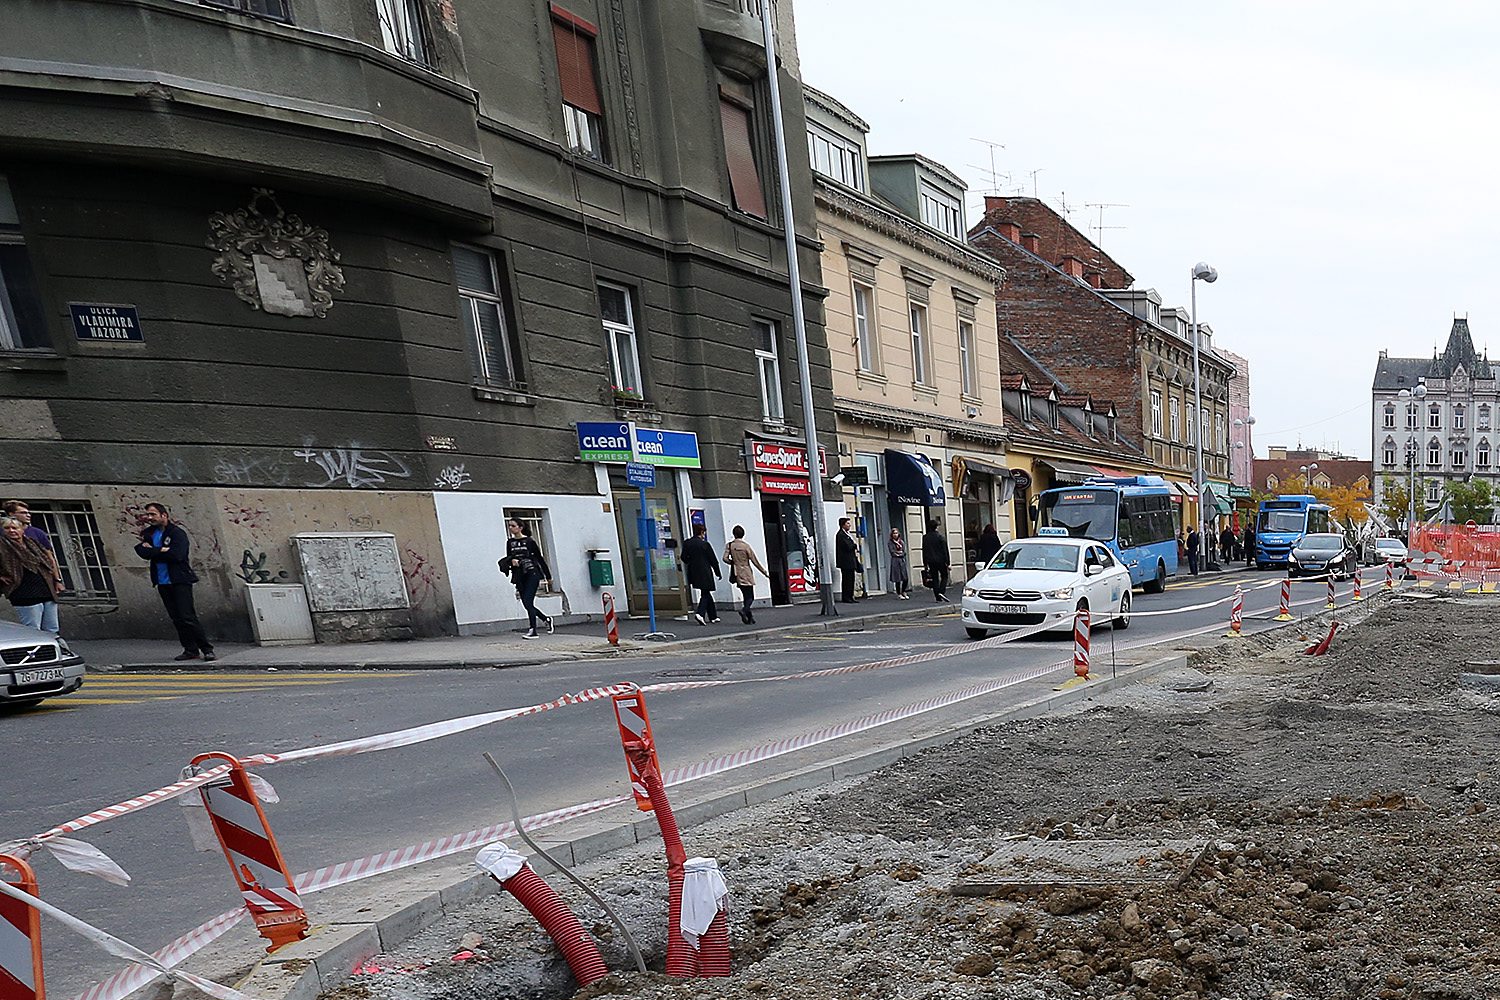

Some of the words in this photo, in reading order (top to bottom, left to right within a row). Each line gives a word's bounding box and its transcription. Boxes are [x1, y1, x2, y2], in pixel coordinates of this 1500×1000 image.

[90, 307, 117, 315] ULICA
[79, 315, 134, 328] VLADIMIRA
[90, 327, 129, 339] NAZORA
[756, 444, 802, 469] SuperSport
[765, 481, 805, 491] www.supersport.hr
[20, 671, 31, 683] ZG
